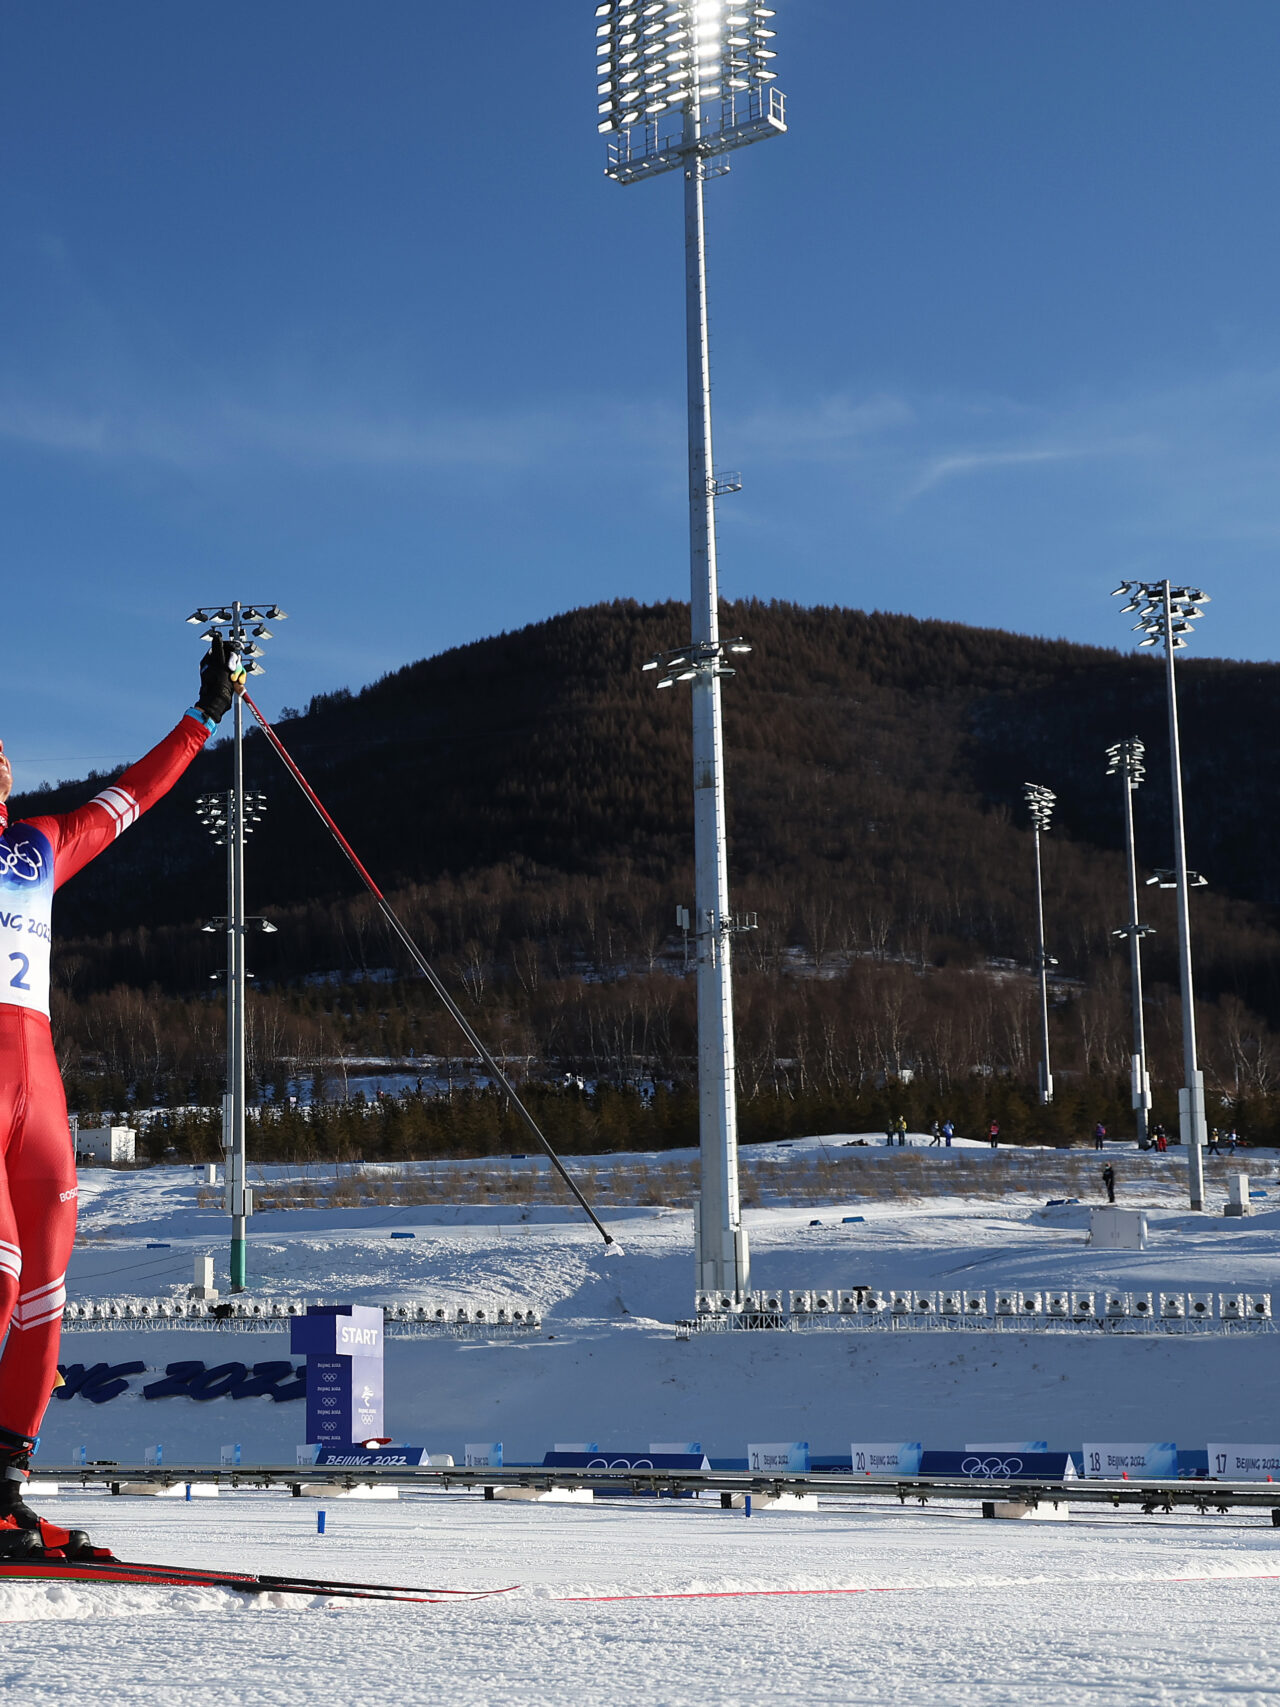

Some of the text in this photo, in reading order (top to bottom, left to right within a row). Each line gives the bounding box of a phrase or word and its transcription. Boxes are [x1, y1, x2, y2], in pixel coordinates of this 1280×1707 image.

[8, 951, 31, 991] 2
[341, 1326, 378, 1346] START
[372, 1455, 408, 1466] 2022
[856, 1452, 866, 1470] 20
[1089, 1452, 1147, 1471] 18 BEIJING 2022
[1215, 1453, 1227, 1474] 17
[1235, 1456, 1261, 1473] BEIJING
